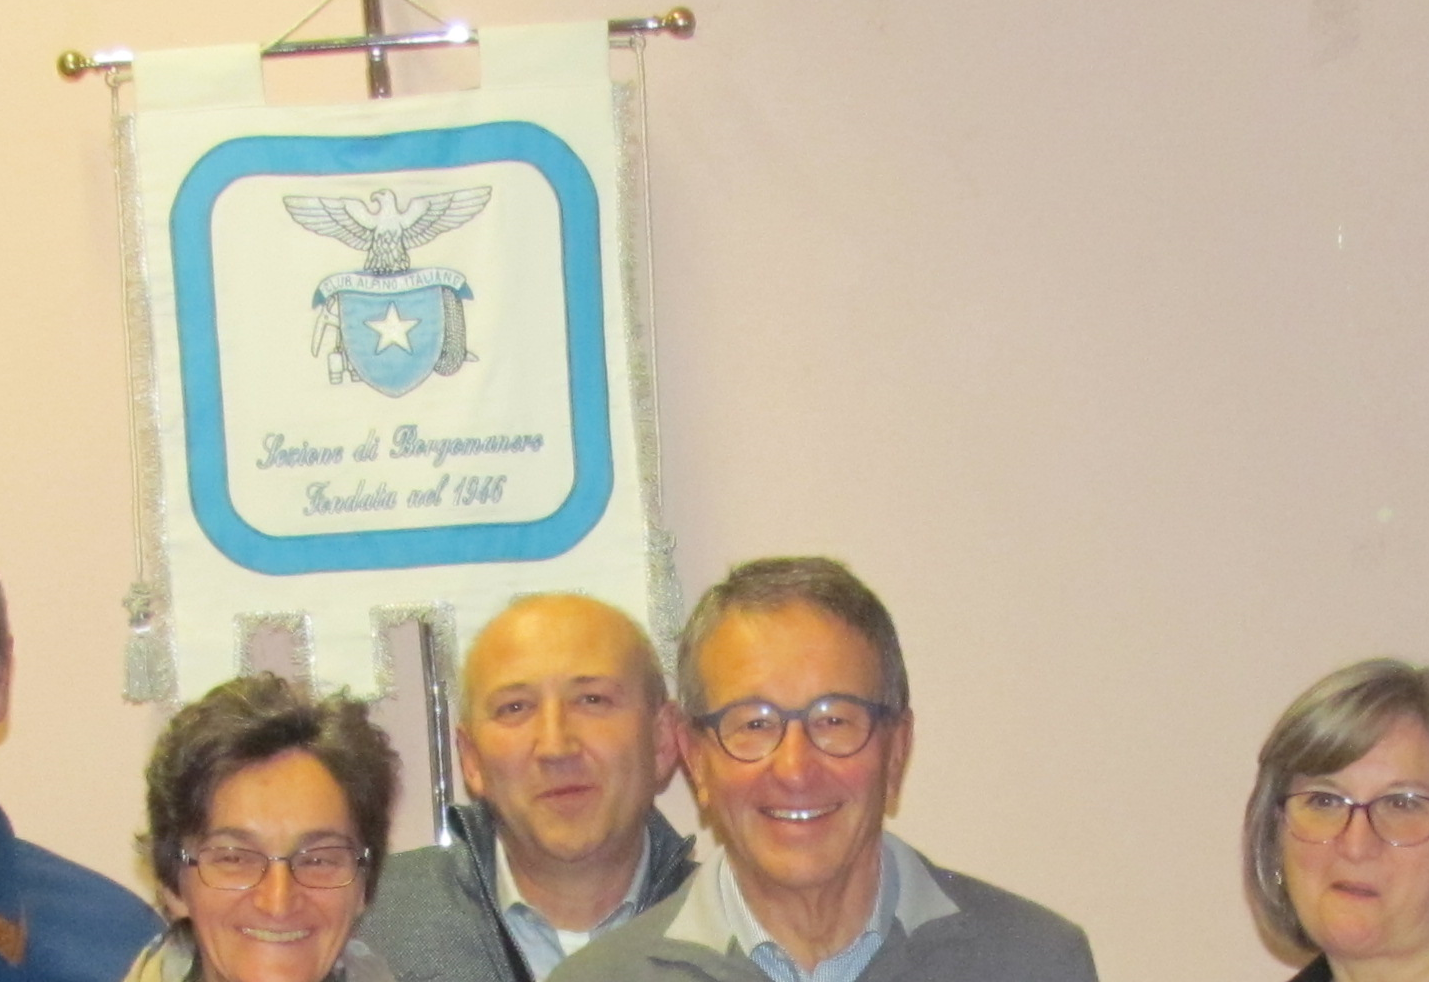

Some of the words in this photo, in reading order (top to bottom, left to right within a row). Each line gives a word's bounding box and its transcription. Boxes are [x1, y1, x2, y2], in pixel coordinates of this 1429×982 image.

[322, 275, 352, 293] CLUB
[357, 278, 398, 290] ALPINO
[405, 270, 461, 286] ITALIANO
[256, 431, 344, 470] Sezione
[352, 428, 381, 463] di
[389, 423, 544, 468] Borgomanero
[302, 480, 398, 516] Fondata
[406, 473, 450, 508] nel
[452, 474, 507, 506] 1946
